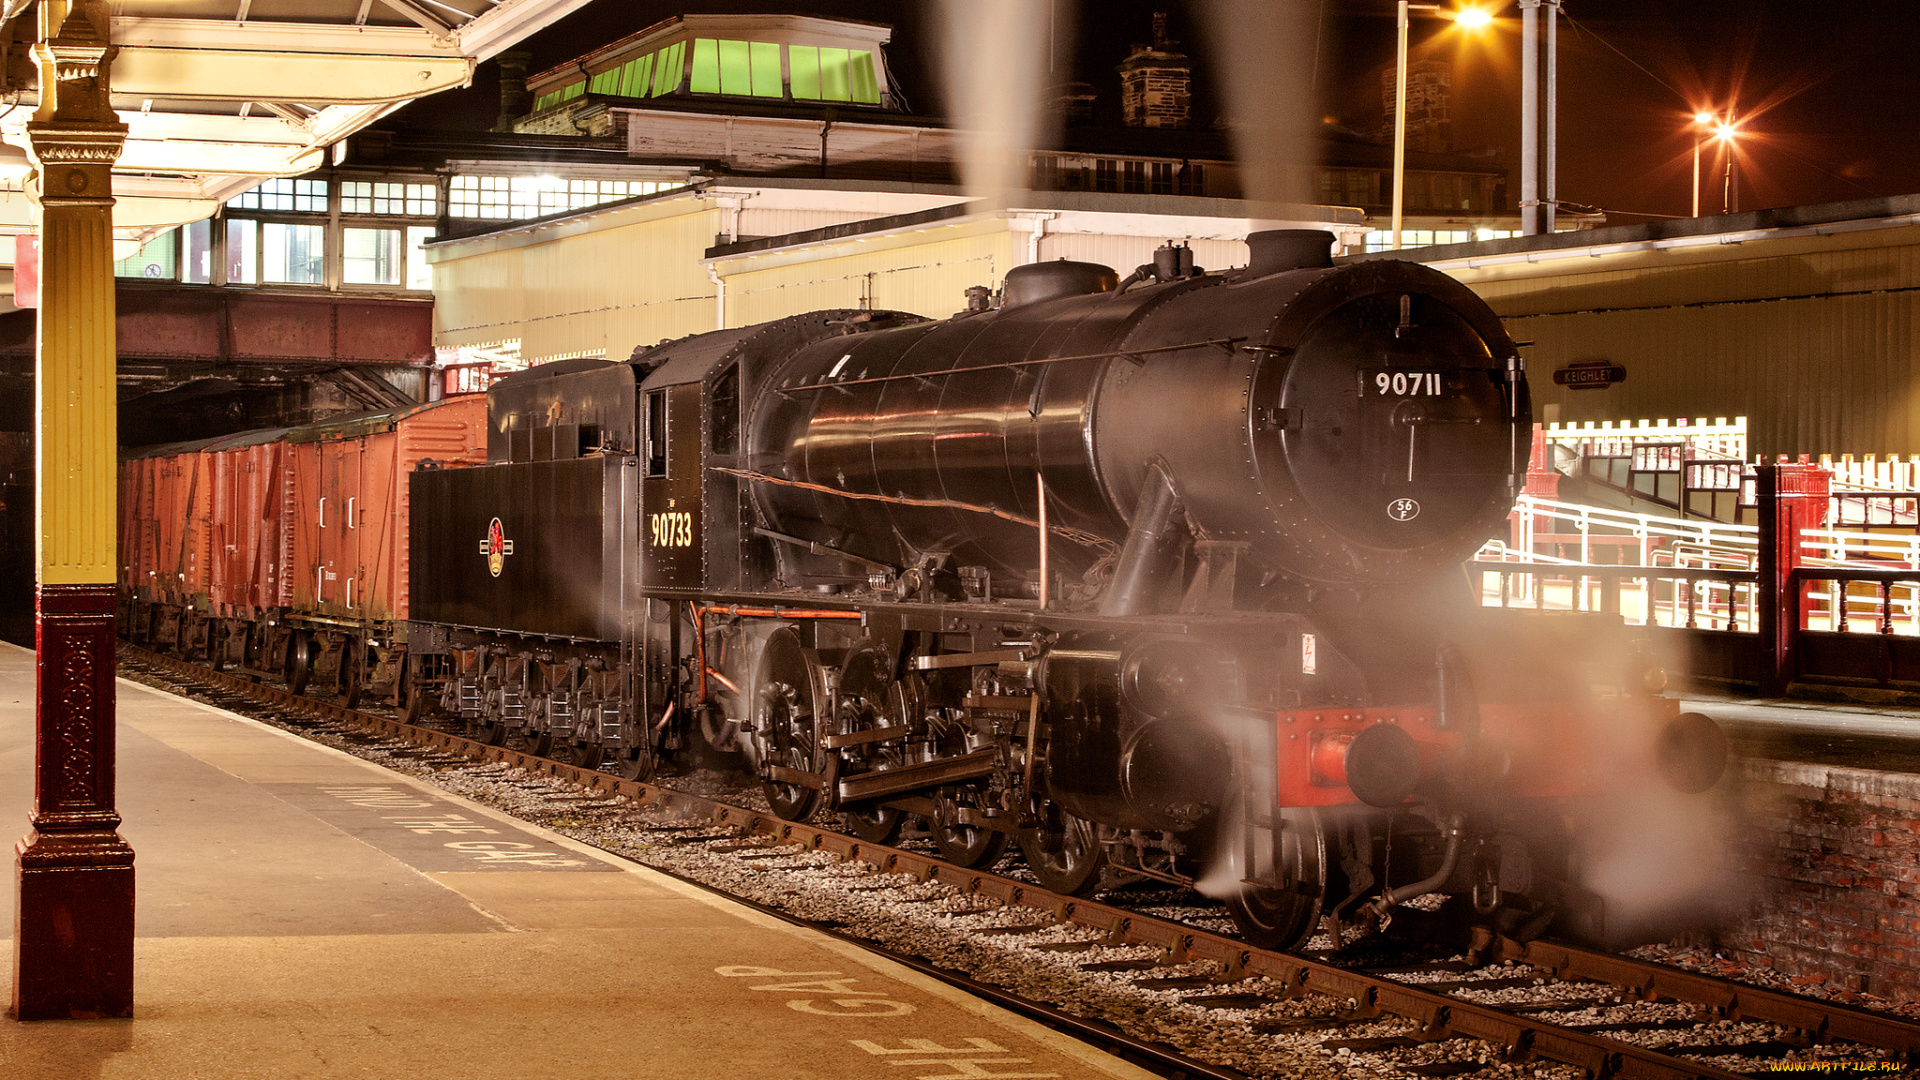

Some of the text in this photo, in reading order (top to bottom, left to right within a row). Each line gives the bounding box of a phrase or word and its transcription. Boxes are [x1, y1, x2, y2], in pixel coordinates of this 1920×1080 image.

[1375, 372, 1441, 396] 90711
[1564, 370, 1612, 382] KEIGHLEY
[1396, 500, 1413, 511] 56
[1400, 510, 1408, 519] F
[651, 512, 692, 547] 90733
[381, 813, 501, 835] THE
[443, 841, 587, 866] GAP
[714, 965, 1063, 1080] HE GAP
